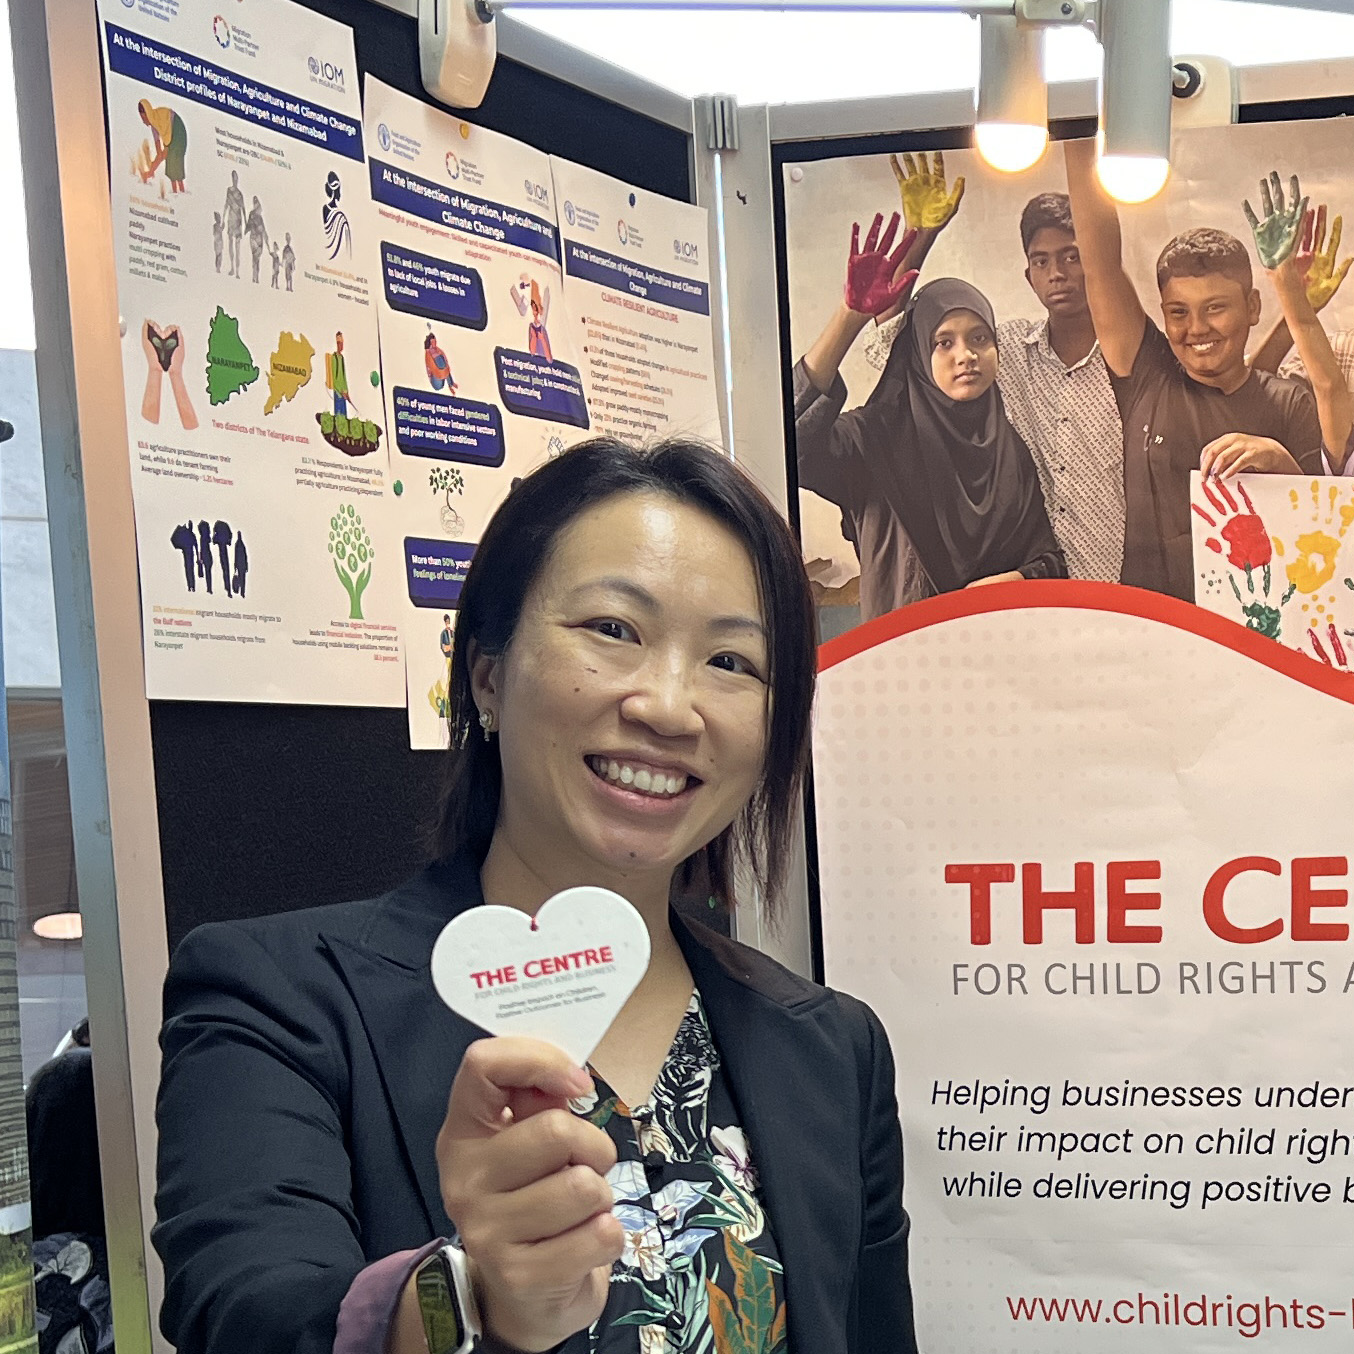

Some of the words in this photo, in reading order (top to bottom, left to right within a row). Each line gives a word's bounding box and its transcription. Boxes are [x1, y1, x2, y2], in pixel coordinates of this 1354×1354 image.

[945, 860, 1163, 947] THE
[470, 964, 518, 989] THE
[523, 946, 613, 979] CENTRE
[953, 963, 1029, 996] FOR
[1045, 962, 1160, 995] CHILD
[1179, 960, 1326, 995] RIGHTS
[932, 1079, 1051, 1115] Helping
[1062, 1080, 1243, 1107] businesses
[937, 1125, 1008, 1152] their
[1018, 1125, 1134, 1161] impact
[1143, 1133, 1183, 1154] on
[1195, 1127, 1276, 1155] child
[943, 1171, 1022, 1198] while
[1033, 1172, 1191, 1209] delivering
[1202, 1175, 1331, 1209] positive
